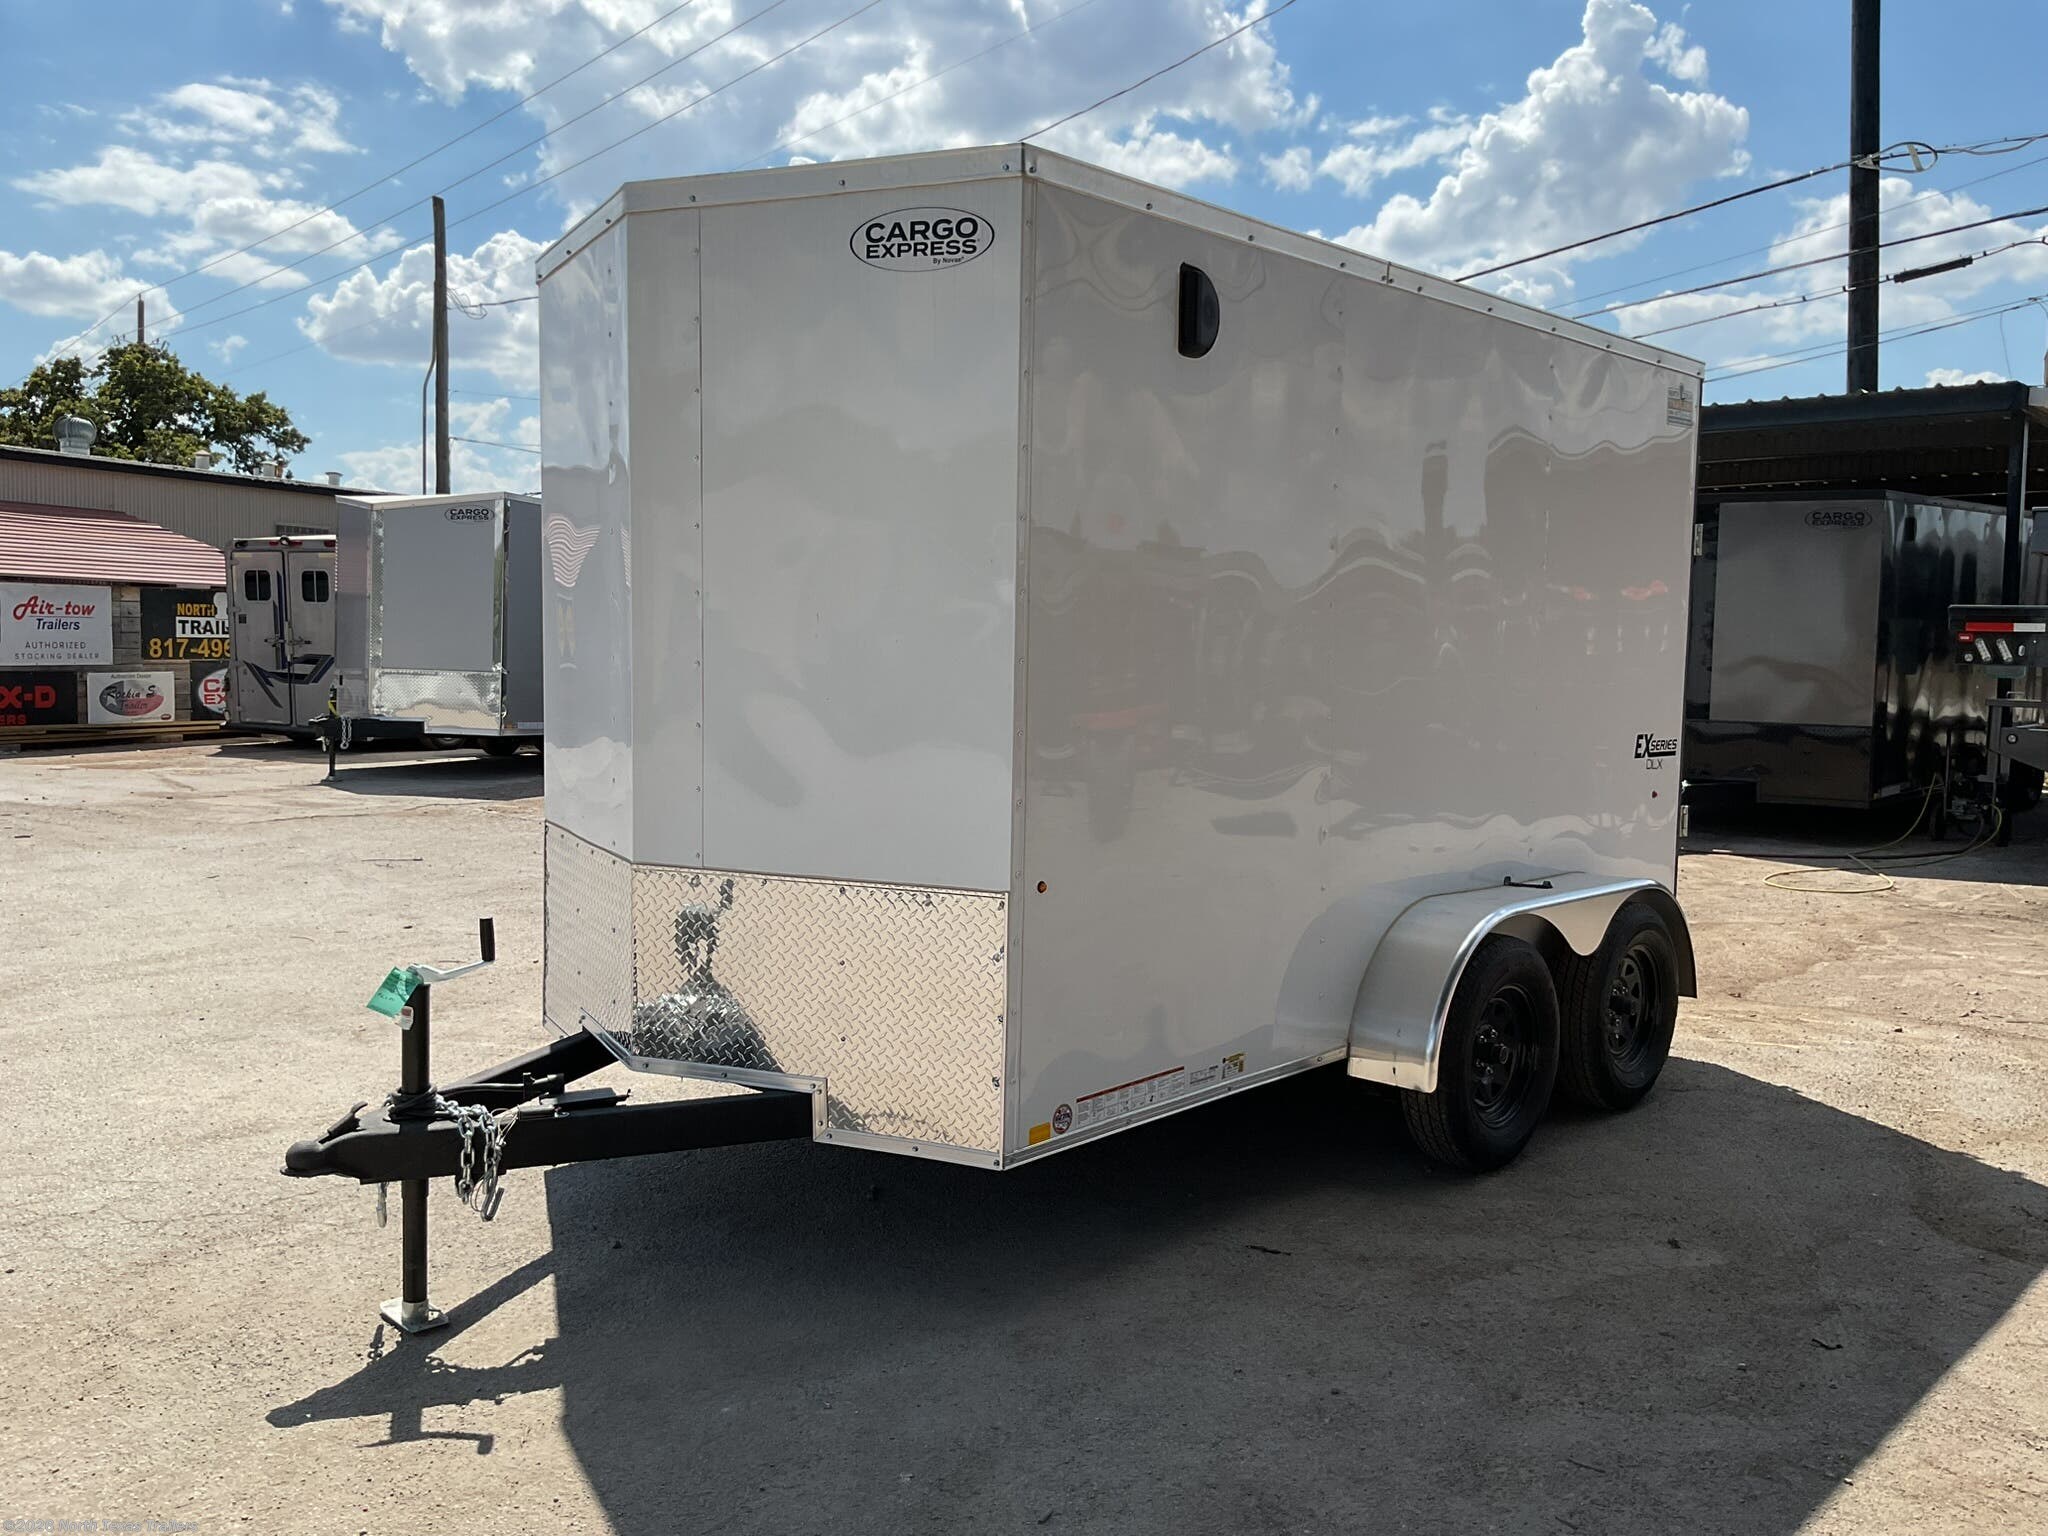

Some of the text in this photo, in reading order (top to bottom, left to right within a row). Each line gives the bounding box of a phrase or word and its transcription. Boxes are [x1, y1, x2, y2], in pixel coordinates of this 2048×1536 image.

[865, 217, 979, 244] CARGO
[866, 239, 978, 259] EXPRESS
[450, 508, 489, 516] CARGO
[1812, 511, 1865, 520] CARGO
[13, 595, 96, 620] Air-tow
[176, 602, 215, 616] NORTH
[36, 618, 81, 630] Trailers
[25, 641, 87, 649] AUTHORIZED
[15, 652, 63, 660] STOCKING
[1646, 758, 1664, 770] DLX
